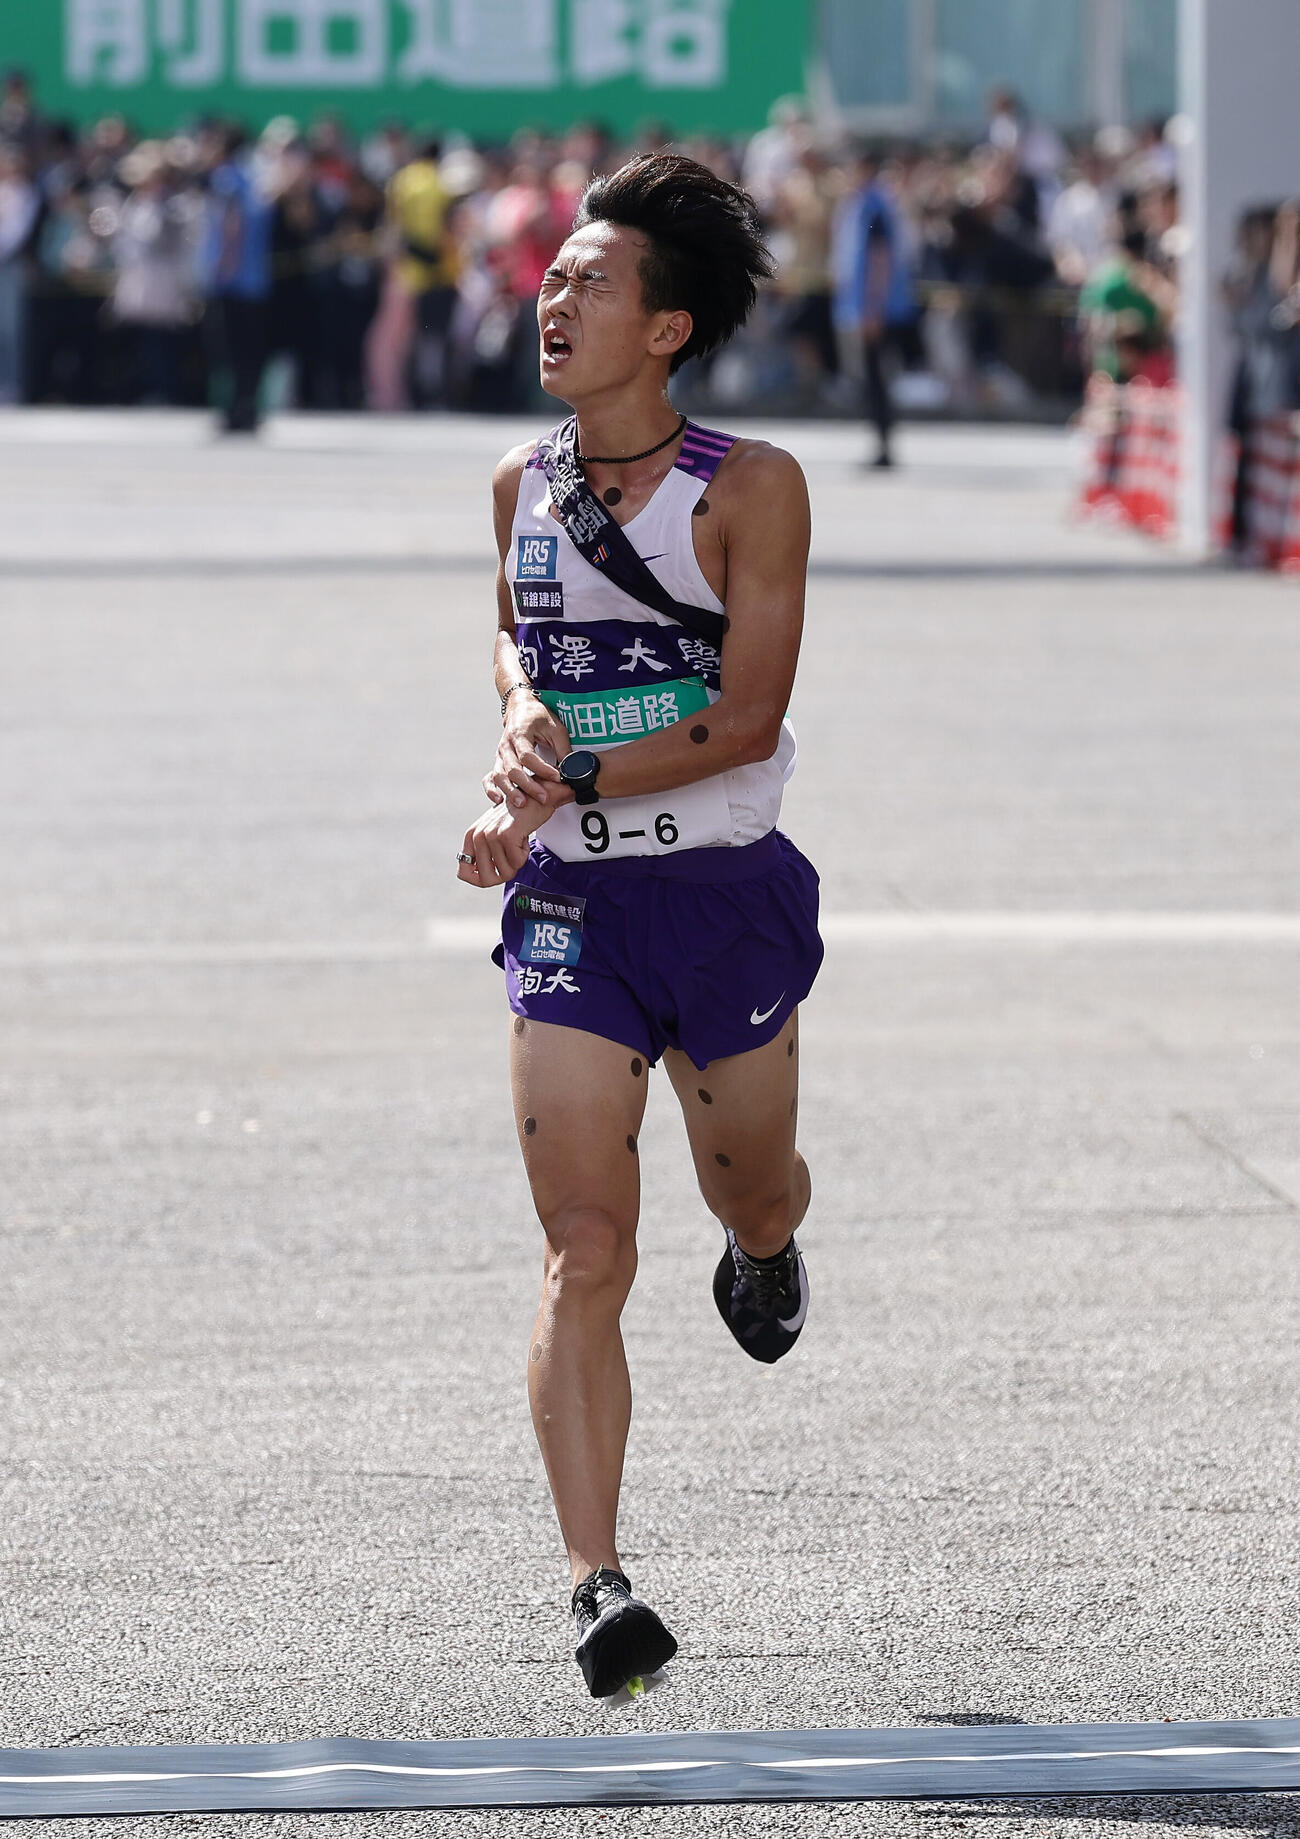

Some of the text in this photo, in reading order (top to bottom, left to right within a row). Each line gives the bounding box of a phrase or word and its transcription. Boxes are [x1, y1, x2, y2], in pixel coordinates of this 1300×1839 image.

[522, 540, 550, 563] HRS
[580, 810, 679, 854] 9-6
[532, 923, 571, 950] HRS
